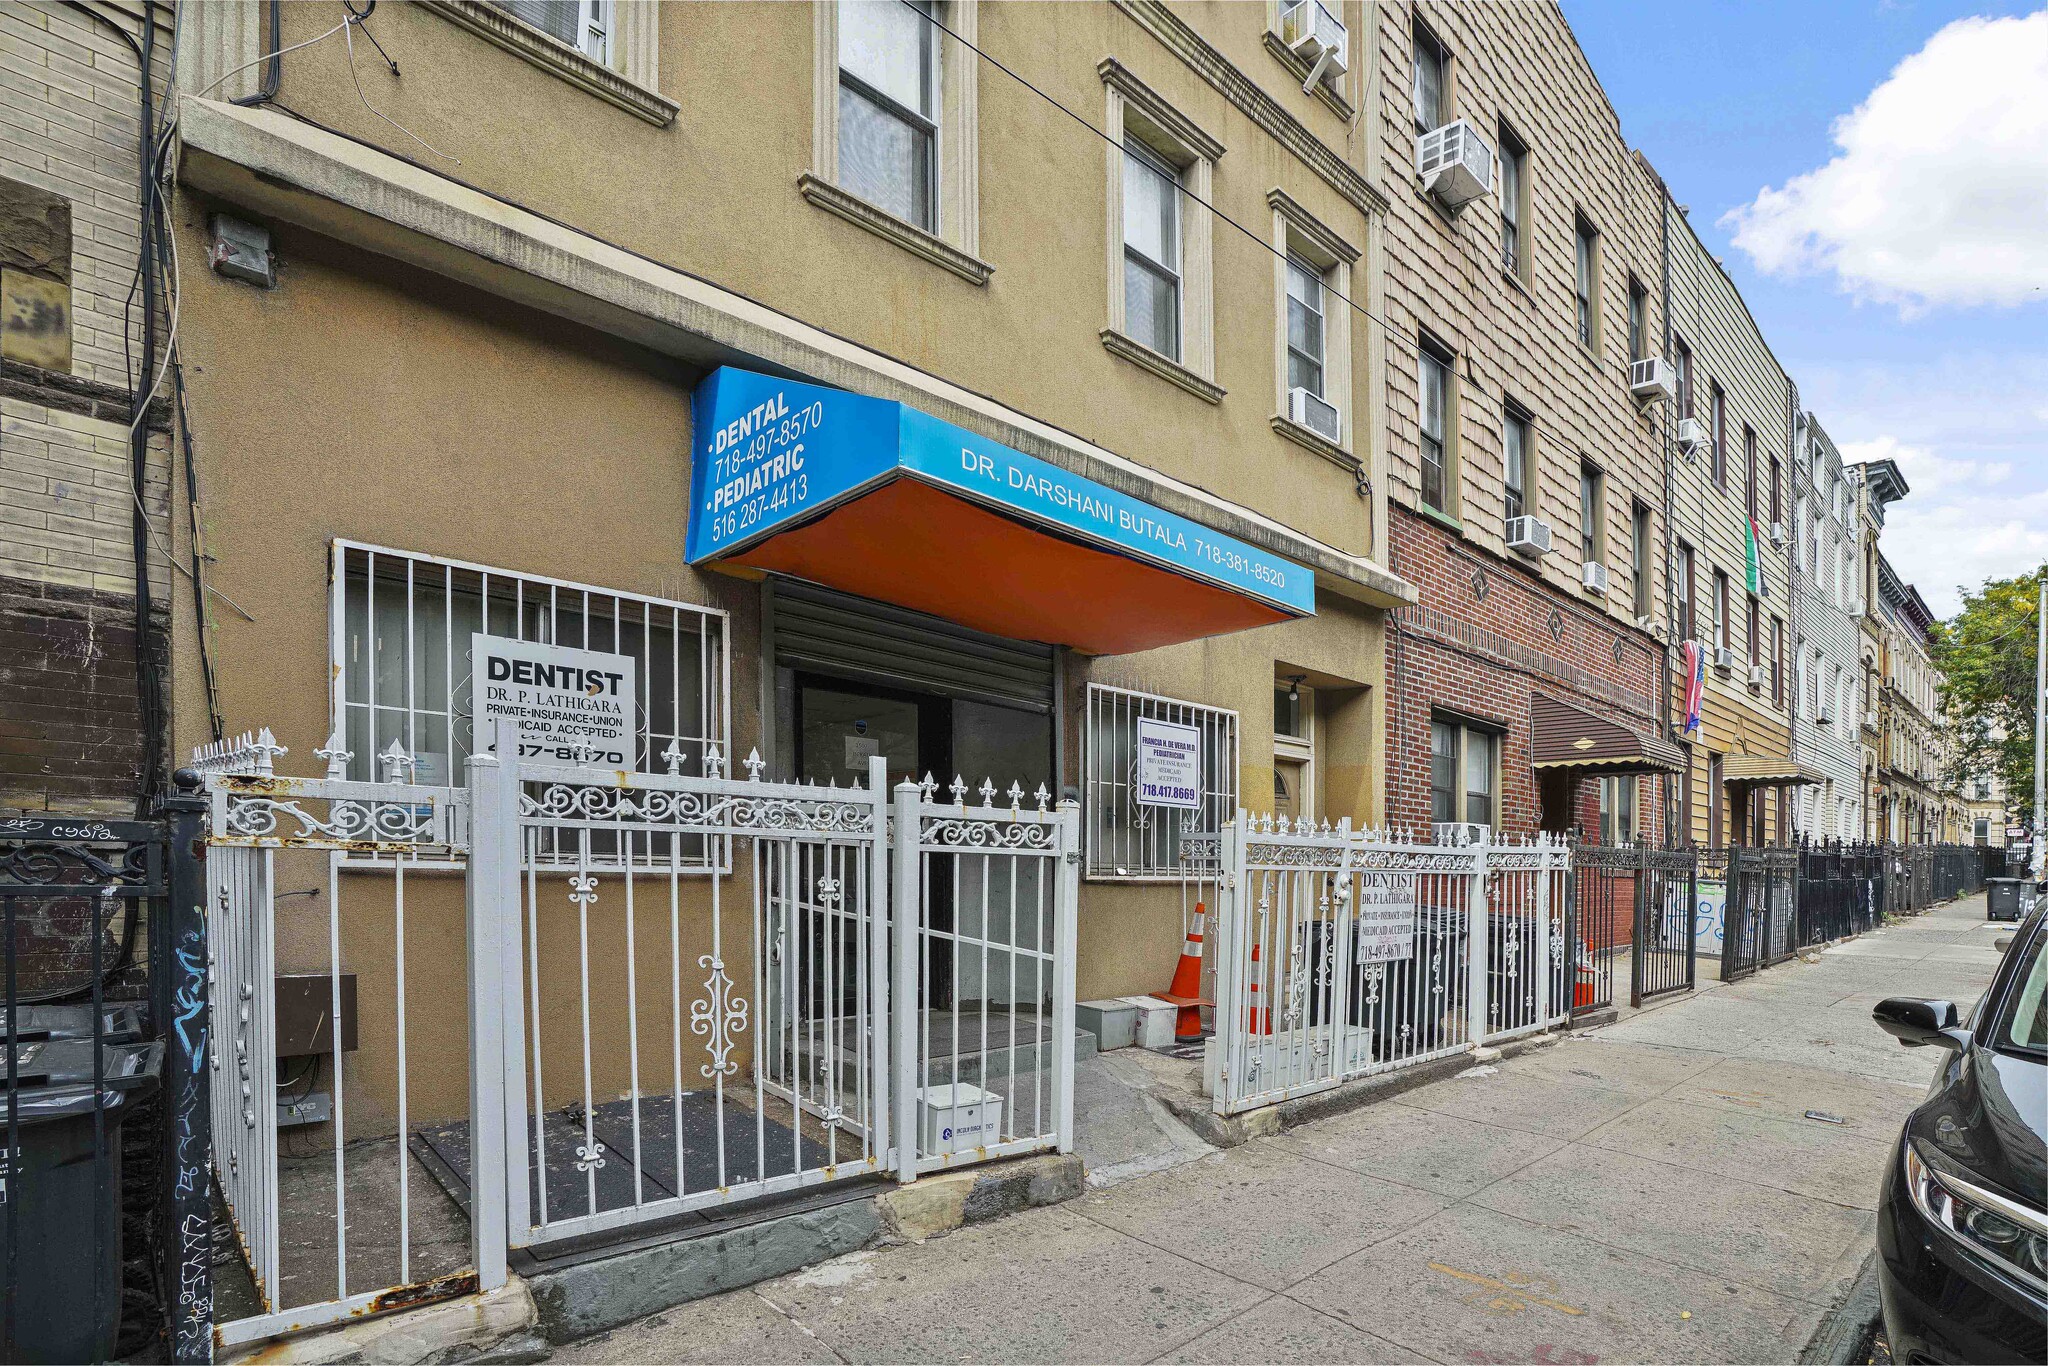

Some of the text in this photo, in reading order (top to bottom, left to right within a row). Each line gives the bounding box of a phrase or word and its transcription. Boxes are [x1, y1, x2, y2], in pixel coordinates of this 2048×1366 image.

[716, 391, 789, 454] DENTAL
[715, 401, 822, 483] 718-497-8570
[714, 443, 805, 513] PEDIATRIC
[712, 474, 808, 542] 516 287-4413
[961, 447, 1285, 588] DR. DARSHANI BUTALA 718-381-8520
[487, 655, 623, 696] DENTIST
[487, 686, 622, 714] DR. P. LATHIGARA
[486, 703, 623, 727] PRIVATE INSURANCE UNION
[545, 734, 569, 744] CALL
[557, 724, 617, 739] ACCEPTED
[1153, 749, 1185, 760] PEDIATRICIAN
[1142, 783, 1195, 801] 718.417.8669
[1363, 872, 1413, 887] DENTIST
[1361, 894, 1373, 905] DR.
[1380, 892, 1414, 905] LATHIGARA
[1362, 924, 1411, 936] MEDICAID ACCEPTED
